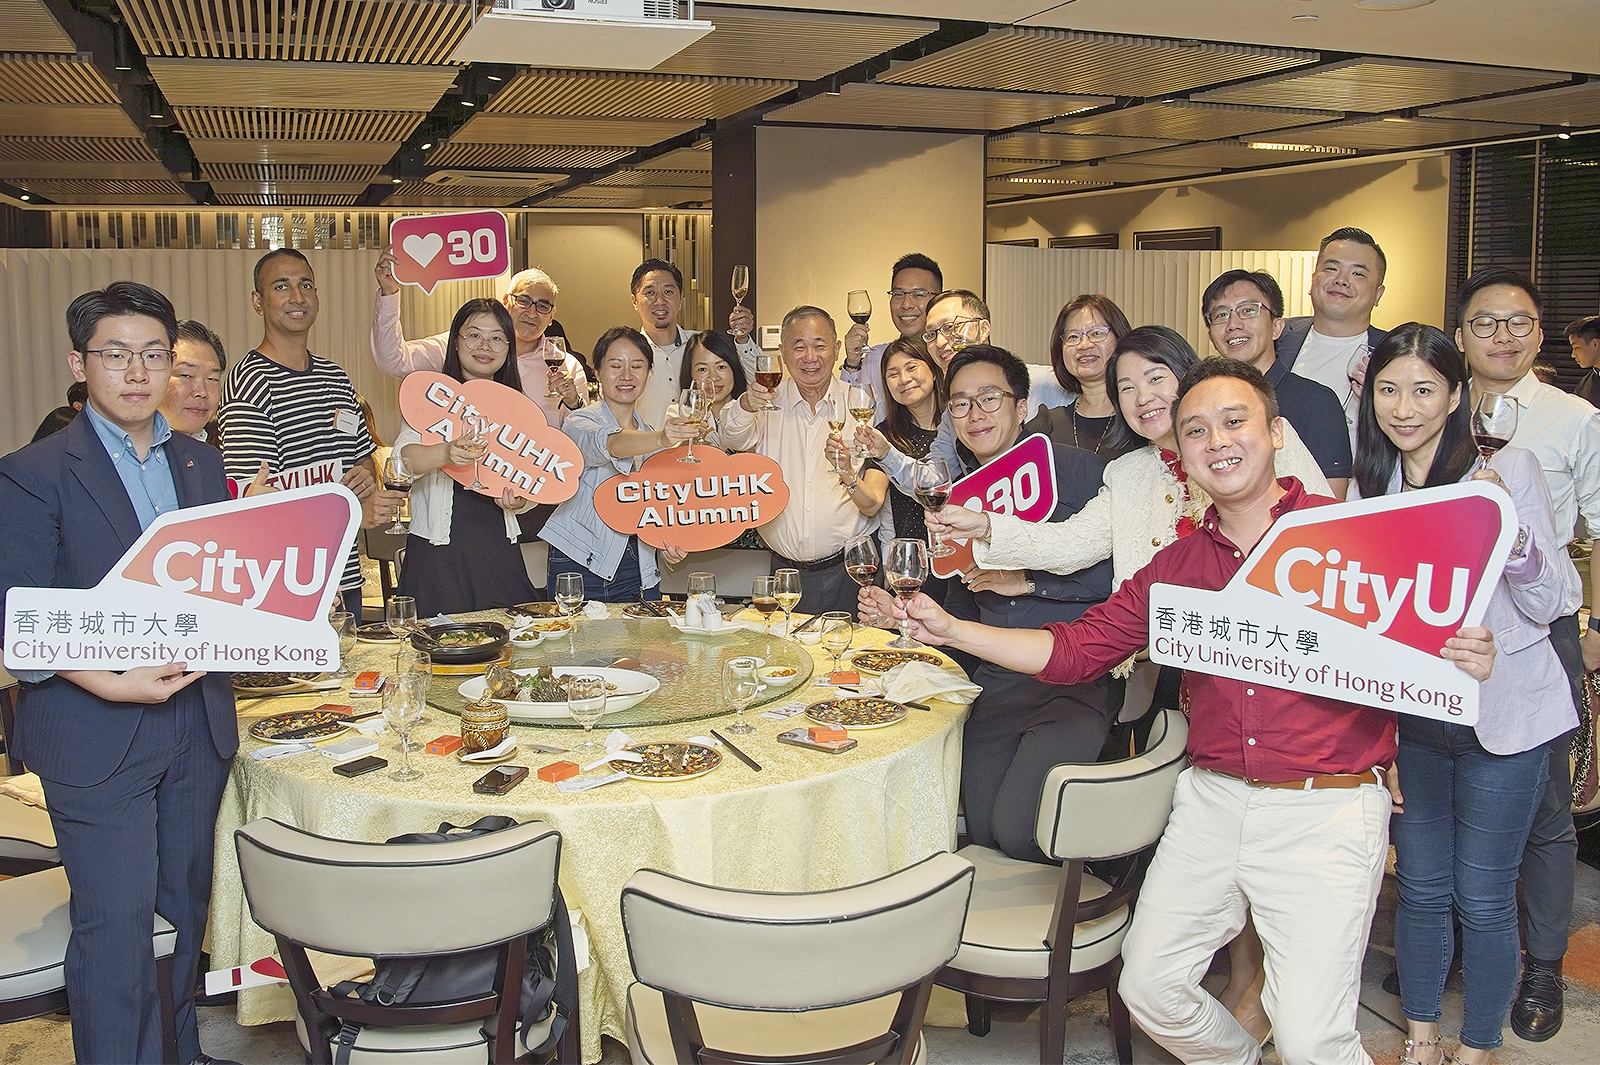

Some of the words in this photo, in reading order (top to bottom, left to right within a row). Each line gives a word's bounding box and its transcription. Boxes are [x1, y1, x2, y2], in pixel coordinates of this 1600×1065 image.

[447, 228, 497, 266] 30
[426, 418, 546, 496] Amni
[616, 472, 775, 505] CityUHK
[986, 461, 1041, 516] 30
[637, 500, 760, 529] Alumni
[152, 540, 328, 609] CityU
[1274, 547, 1469, 634] CityU
[13, 609, 199, 637] 香港城市大學
[1155, 606, 1320, 656] 香港城市大學
[12, 639, 61, 664] City
[66, 640, 180, 664] University
[184, 641, 210, 661] of
[214, 644, 270, 666] Hong
[274, 644, 328, 666] Kong
[1155, 636, 1195, 664] City
[1198, 643, 1301, 684] University
[1305, 664, 1331, 685] of
[1334, 669, 1396, 703] Hong
[1400, 681, 1464, 716] Kong
